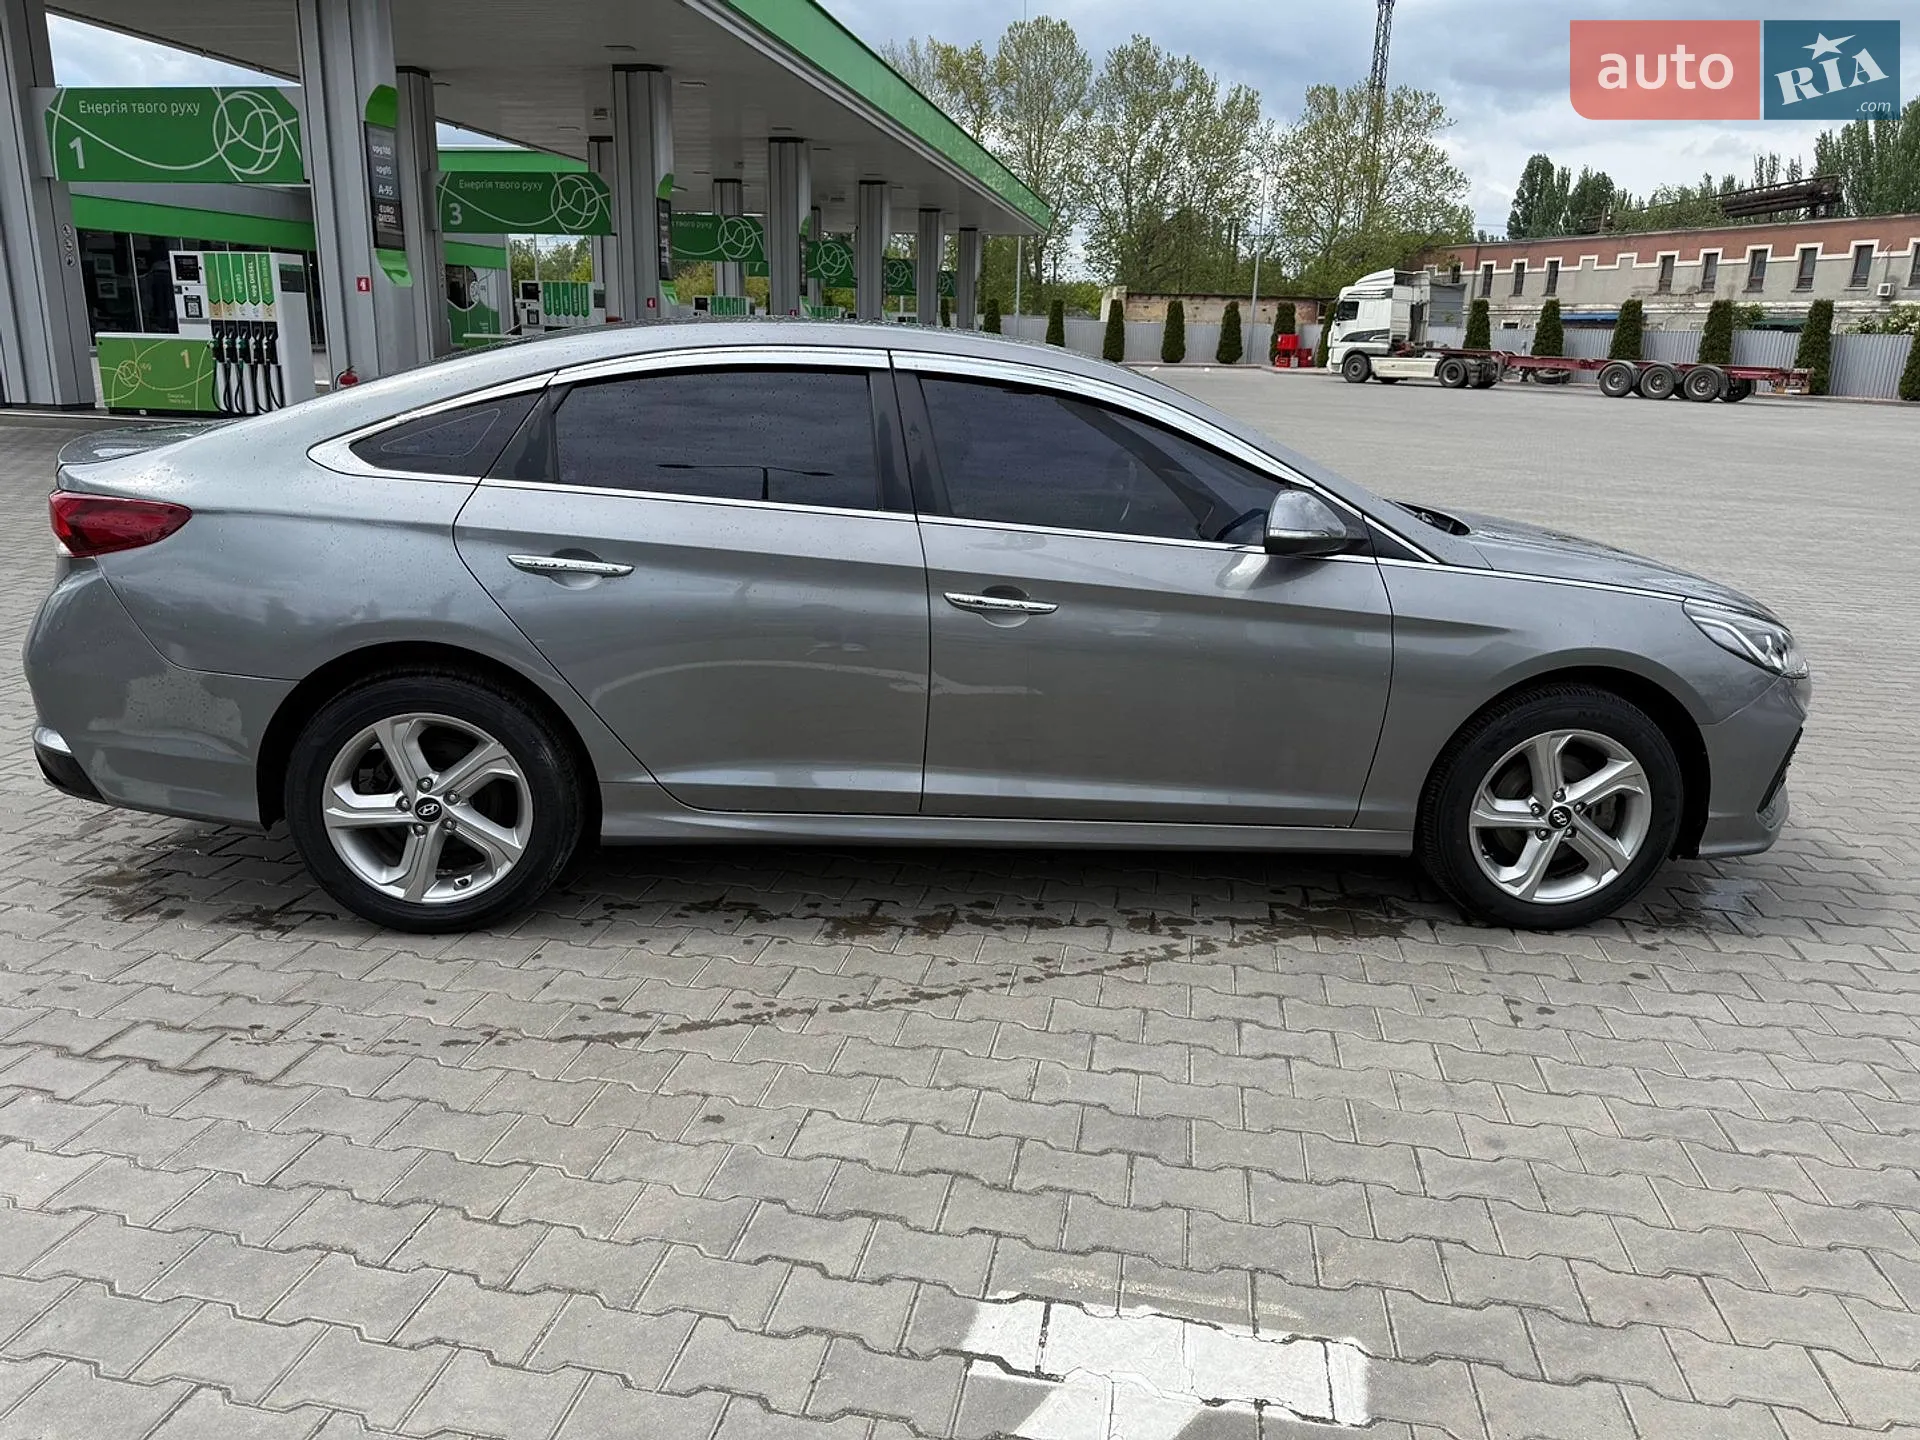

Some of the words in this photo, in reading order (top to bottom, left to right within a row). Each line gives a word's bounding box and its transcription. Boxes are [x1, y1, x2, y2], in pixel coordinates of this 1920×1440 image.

[79, 100, 127, 116] Енергія
[130, 103, 168, 114] твого
[171, 102, 200, 116] руху
[69, 136, 85, 169] 1
[459, 179, 493, 191] Енергія
[495, 181, 520, 189] твого
[522, 181, 543, 192] руху
[449, 202, 462, 225] 3
[180, 349, 191, 369] 1
